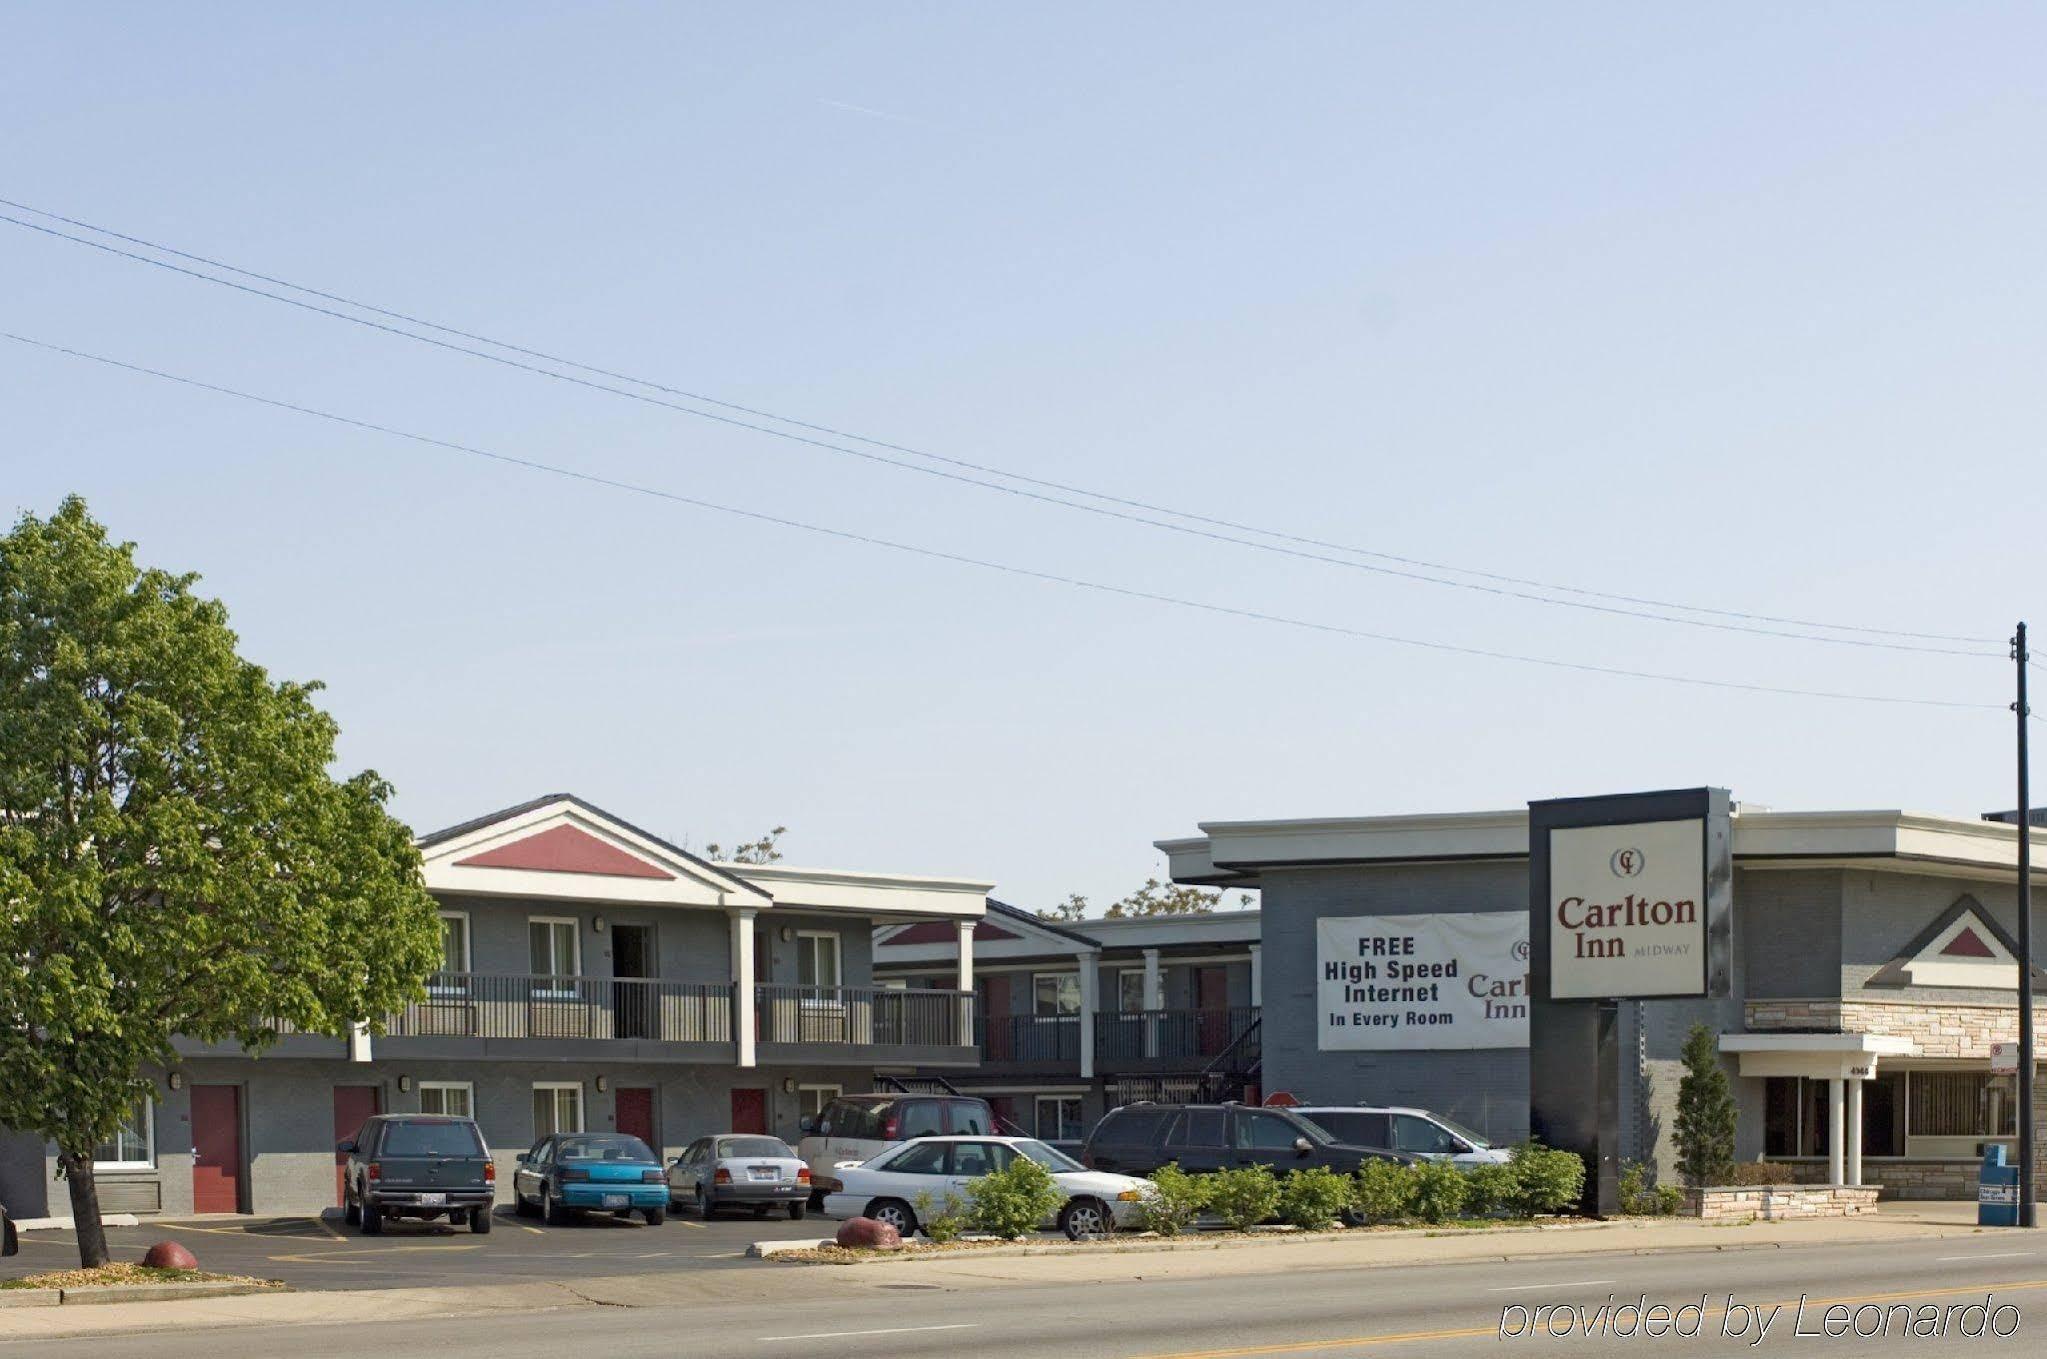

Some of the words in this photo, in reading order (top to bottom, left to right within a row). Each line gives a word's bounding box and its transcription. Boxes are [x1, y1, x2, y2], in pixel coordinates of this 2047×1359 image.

[1558, 894, 1697, 929] Carlton
[1358, 937, 1414, 956] FREE
[1574, 932, 1625, 959] Inn
[1633, 944, 1690, 958] MIDWAY
[1325, 961, 1377, 984] High
[1387, 959, 1458, 982] Speed
[1344, 983, 1439, 1003] Internet
[1329, 1012, 1346, 1026] In
[1352, 1012, 1399, 1028] Every
[1405, 1011, 1453, 1026] Room
[1484, 1000, 1526, 1019] Inn
